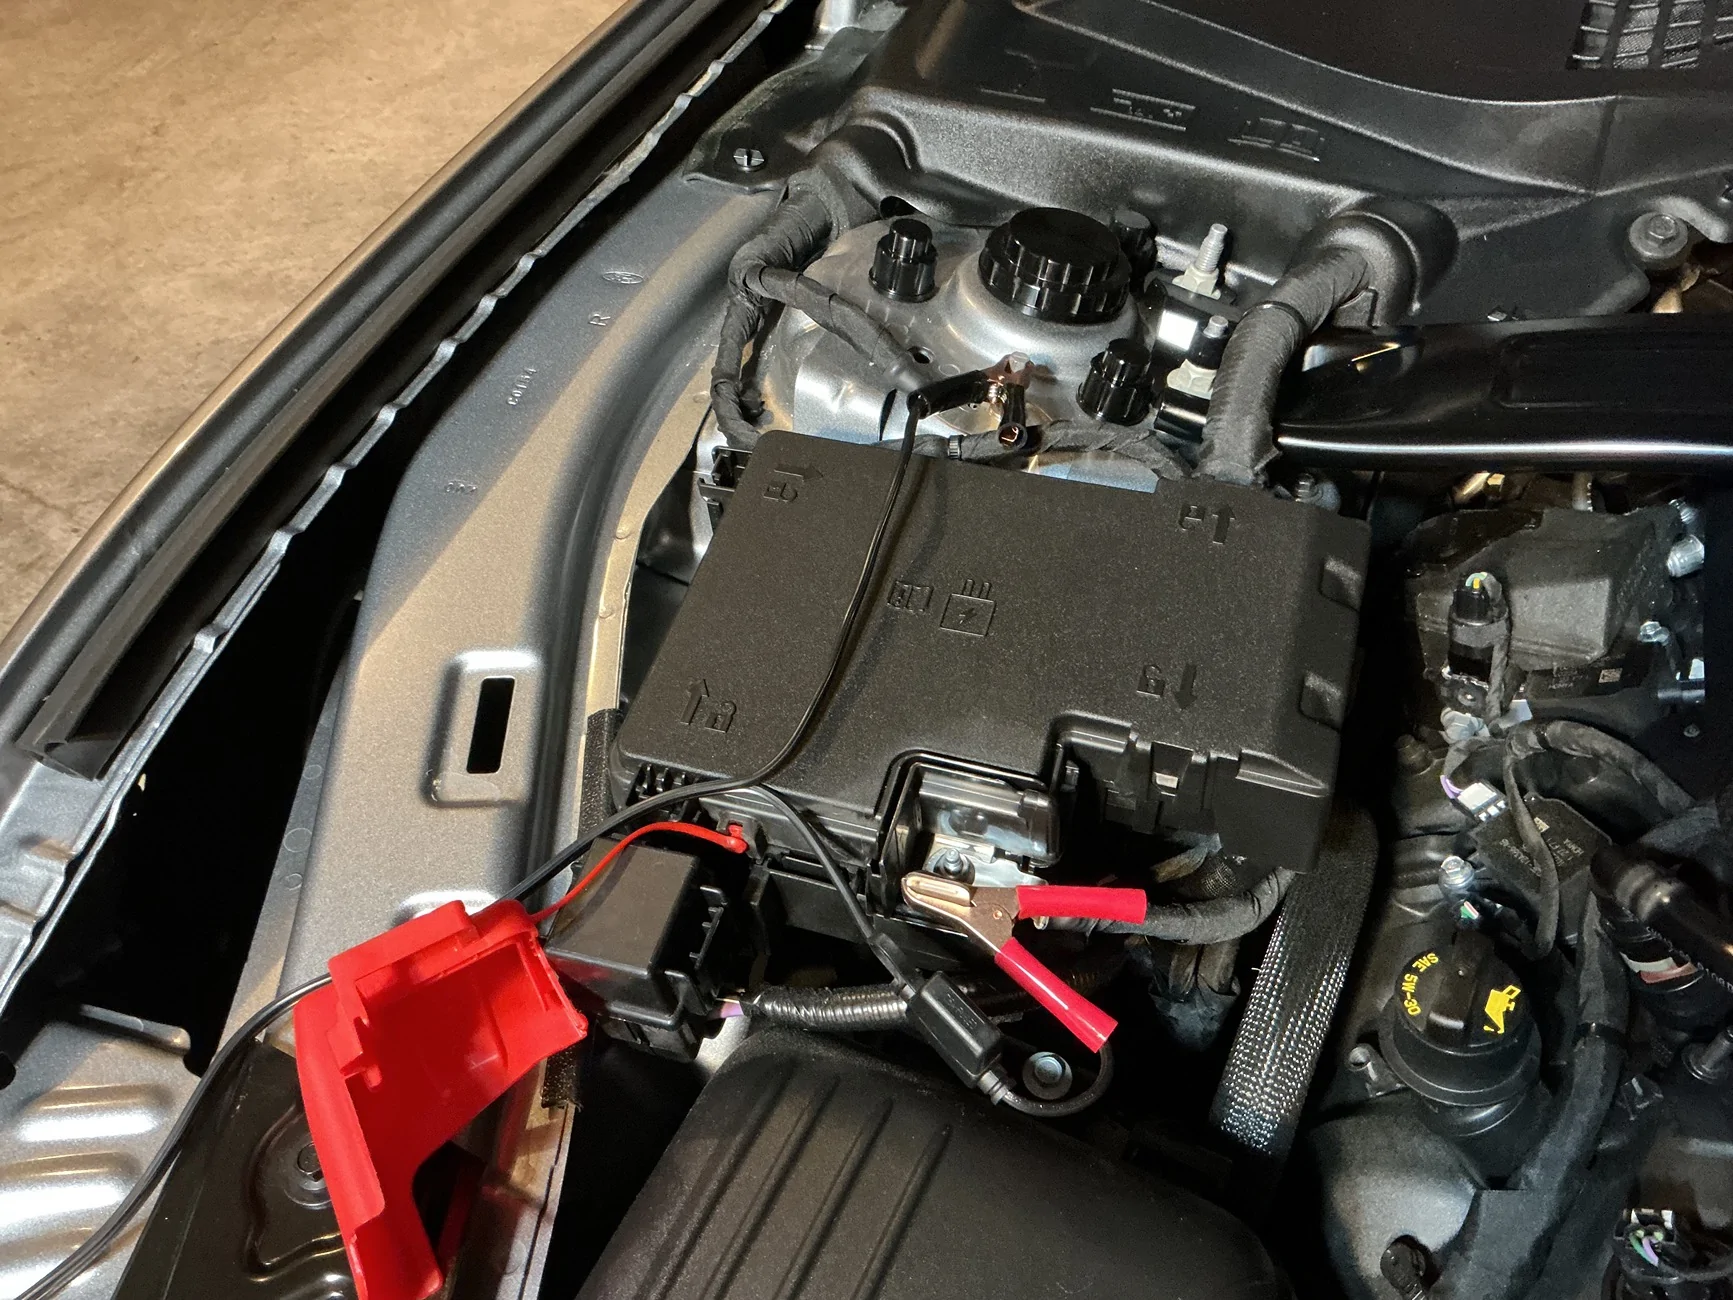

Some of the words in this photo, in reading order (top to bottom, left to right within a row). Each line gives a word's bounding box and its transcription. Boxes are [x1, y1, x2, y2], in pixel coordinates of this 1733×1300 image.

[588, 313, 611, 326] R
[1411, 951, 1440, 973] SAE
[1401, 973, 1422, 1017] 5W-30
